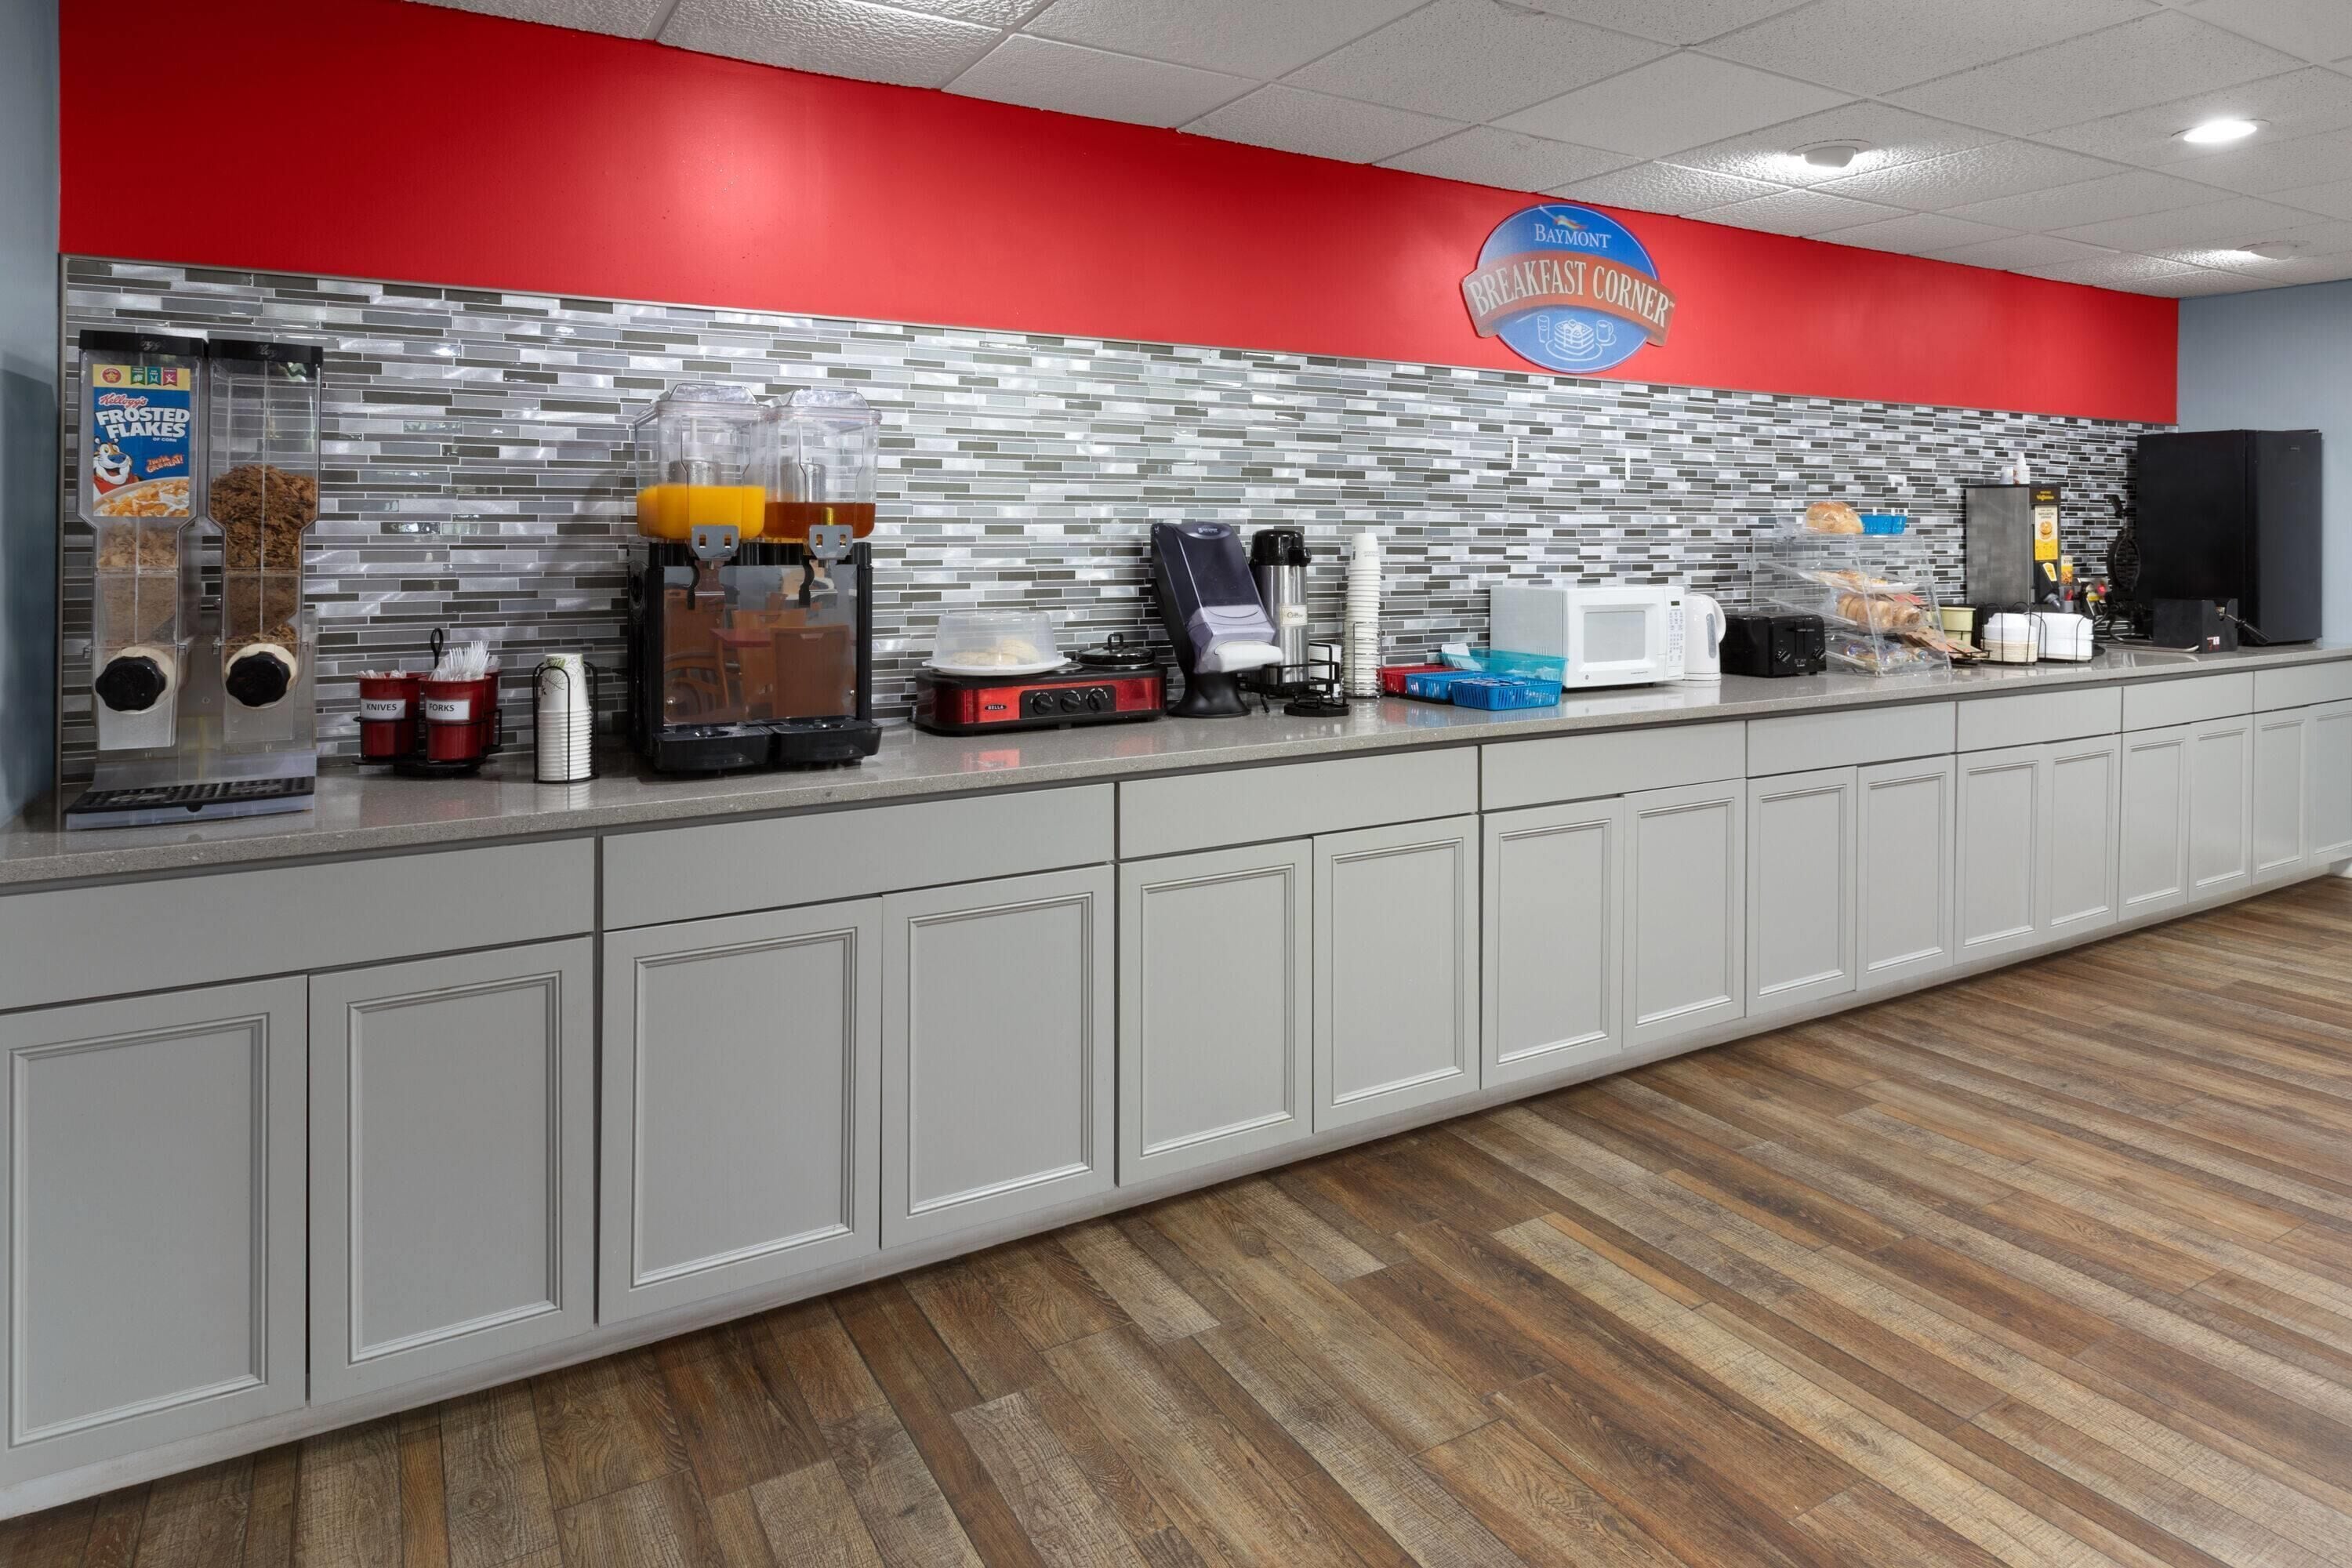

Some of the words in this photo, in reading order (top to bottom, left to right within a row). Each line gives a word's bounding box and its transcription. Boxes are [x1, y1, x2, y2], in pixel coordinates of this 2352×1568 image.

[1534, 223, 1610, 249] BAYMONT
[1468, 259, 1587, 318] BREAKFAST
[1592, 265, 1669, 328] CORNER
[99, 393, 148, 408] Kellogg's
[96, 407, 191, 426] FROSTED
[106, 422, 187, 439] FLAKES
[366, 702, 397, 712] KNIVES
[428, 703, 455, 712] FORKS
